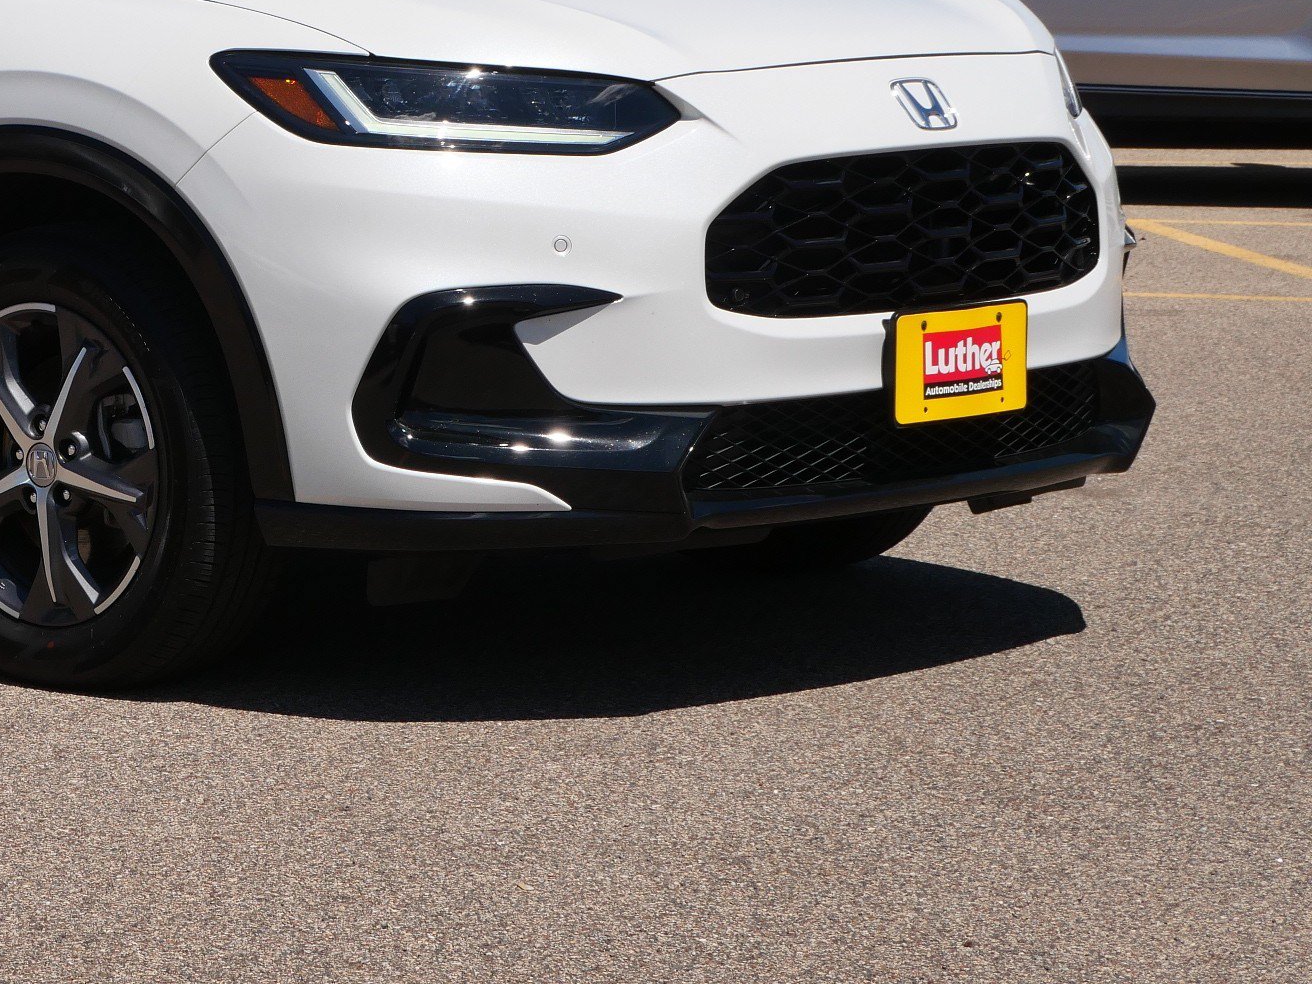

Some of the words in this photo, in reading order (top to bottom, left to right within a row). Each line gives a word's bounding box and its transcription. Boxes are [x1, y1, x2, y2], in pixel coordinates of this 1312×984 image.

[924, 336, 1001, 376] Luther
[925, 382, 968, 396] Automobile
[968, 378, 1002, 392] Dealerships
